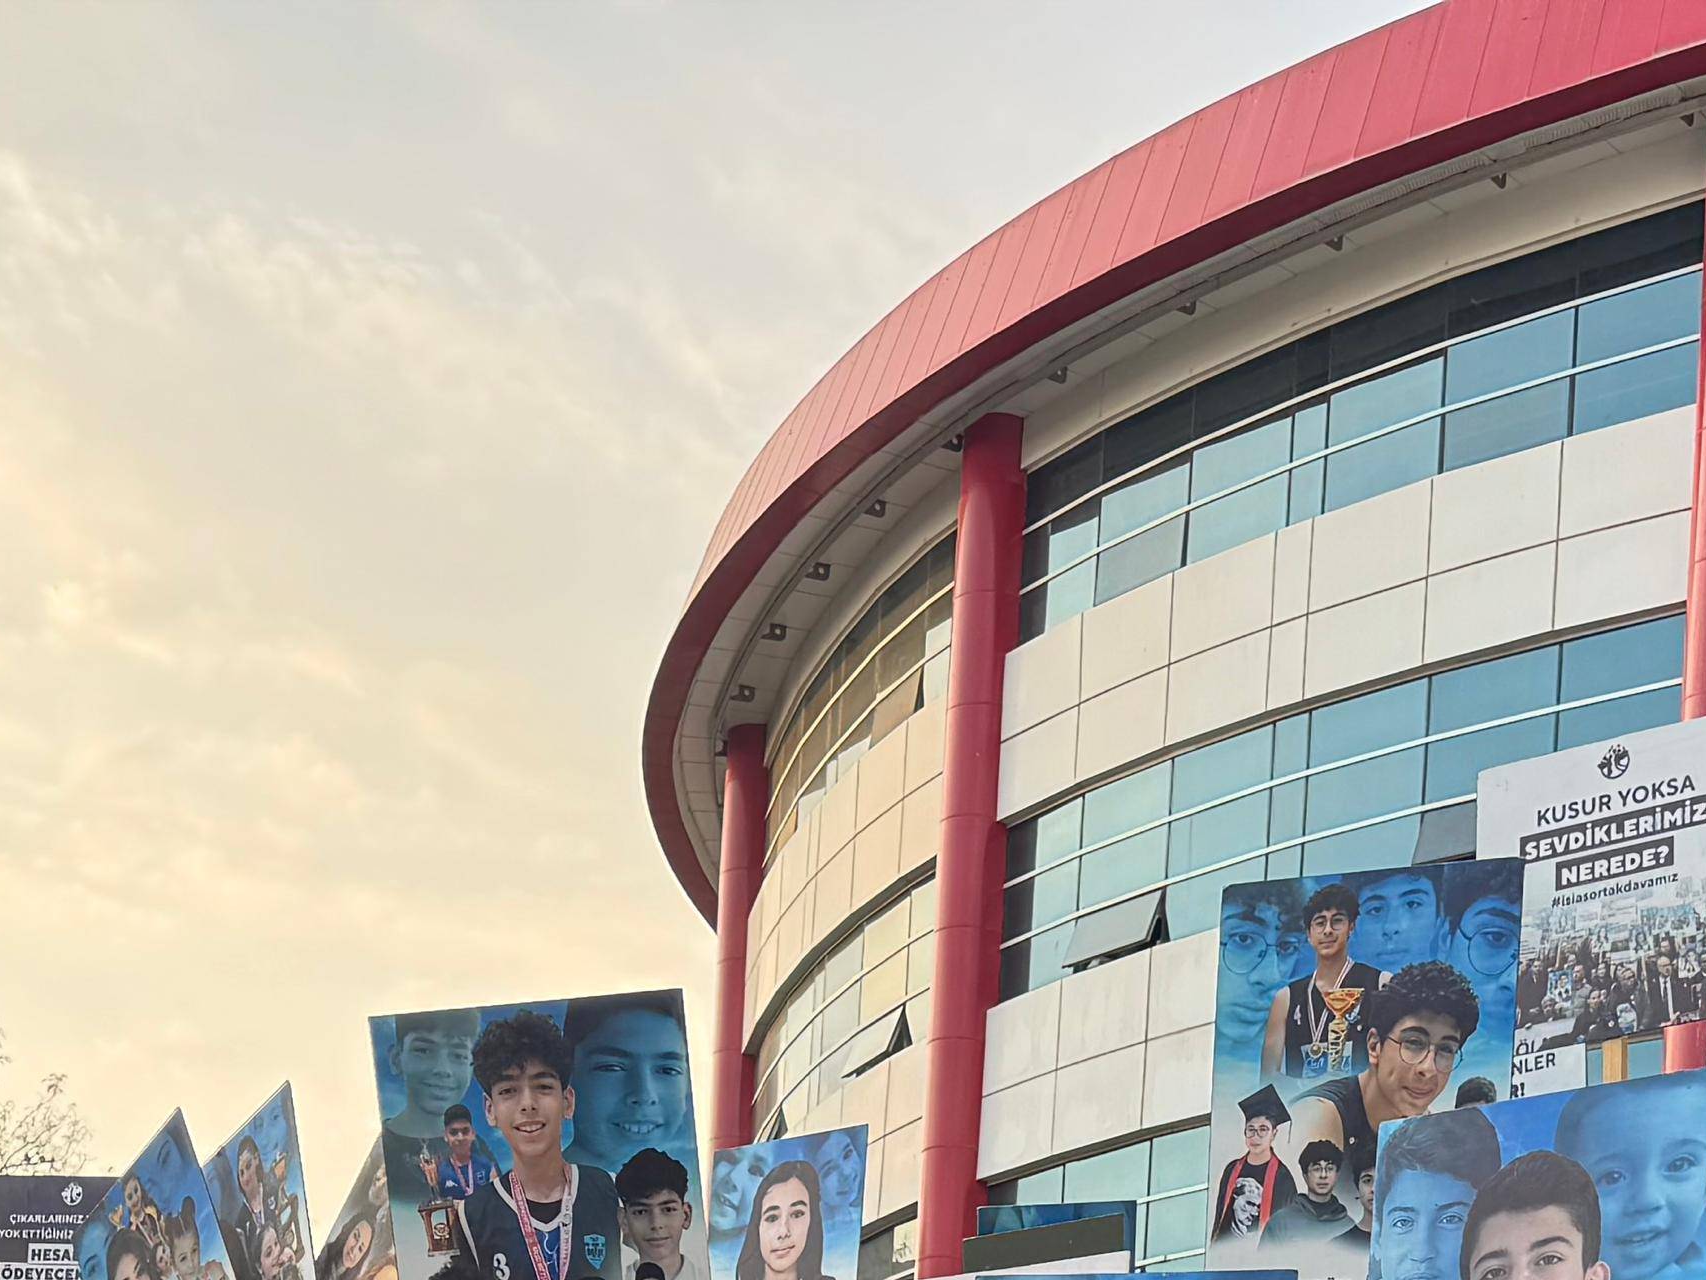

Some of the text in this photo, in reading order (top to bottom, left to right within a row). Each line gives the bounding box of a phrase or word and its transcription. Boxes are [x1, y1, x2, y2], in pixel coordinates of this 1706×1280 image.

[1536, 775, 1695, 828] KUSUR YOKSA
[1560, 844, 1670, 887] NEREDE?
